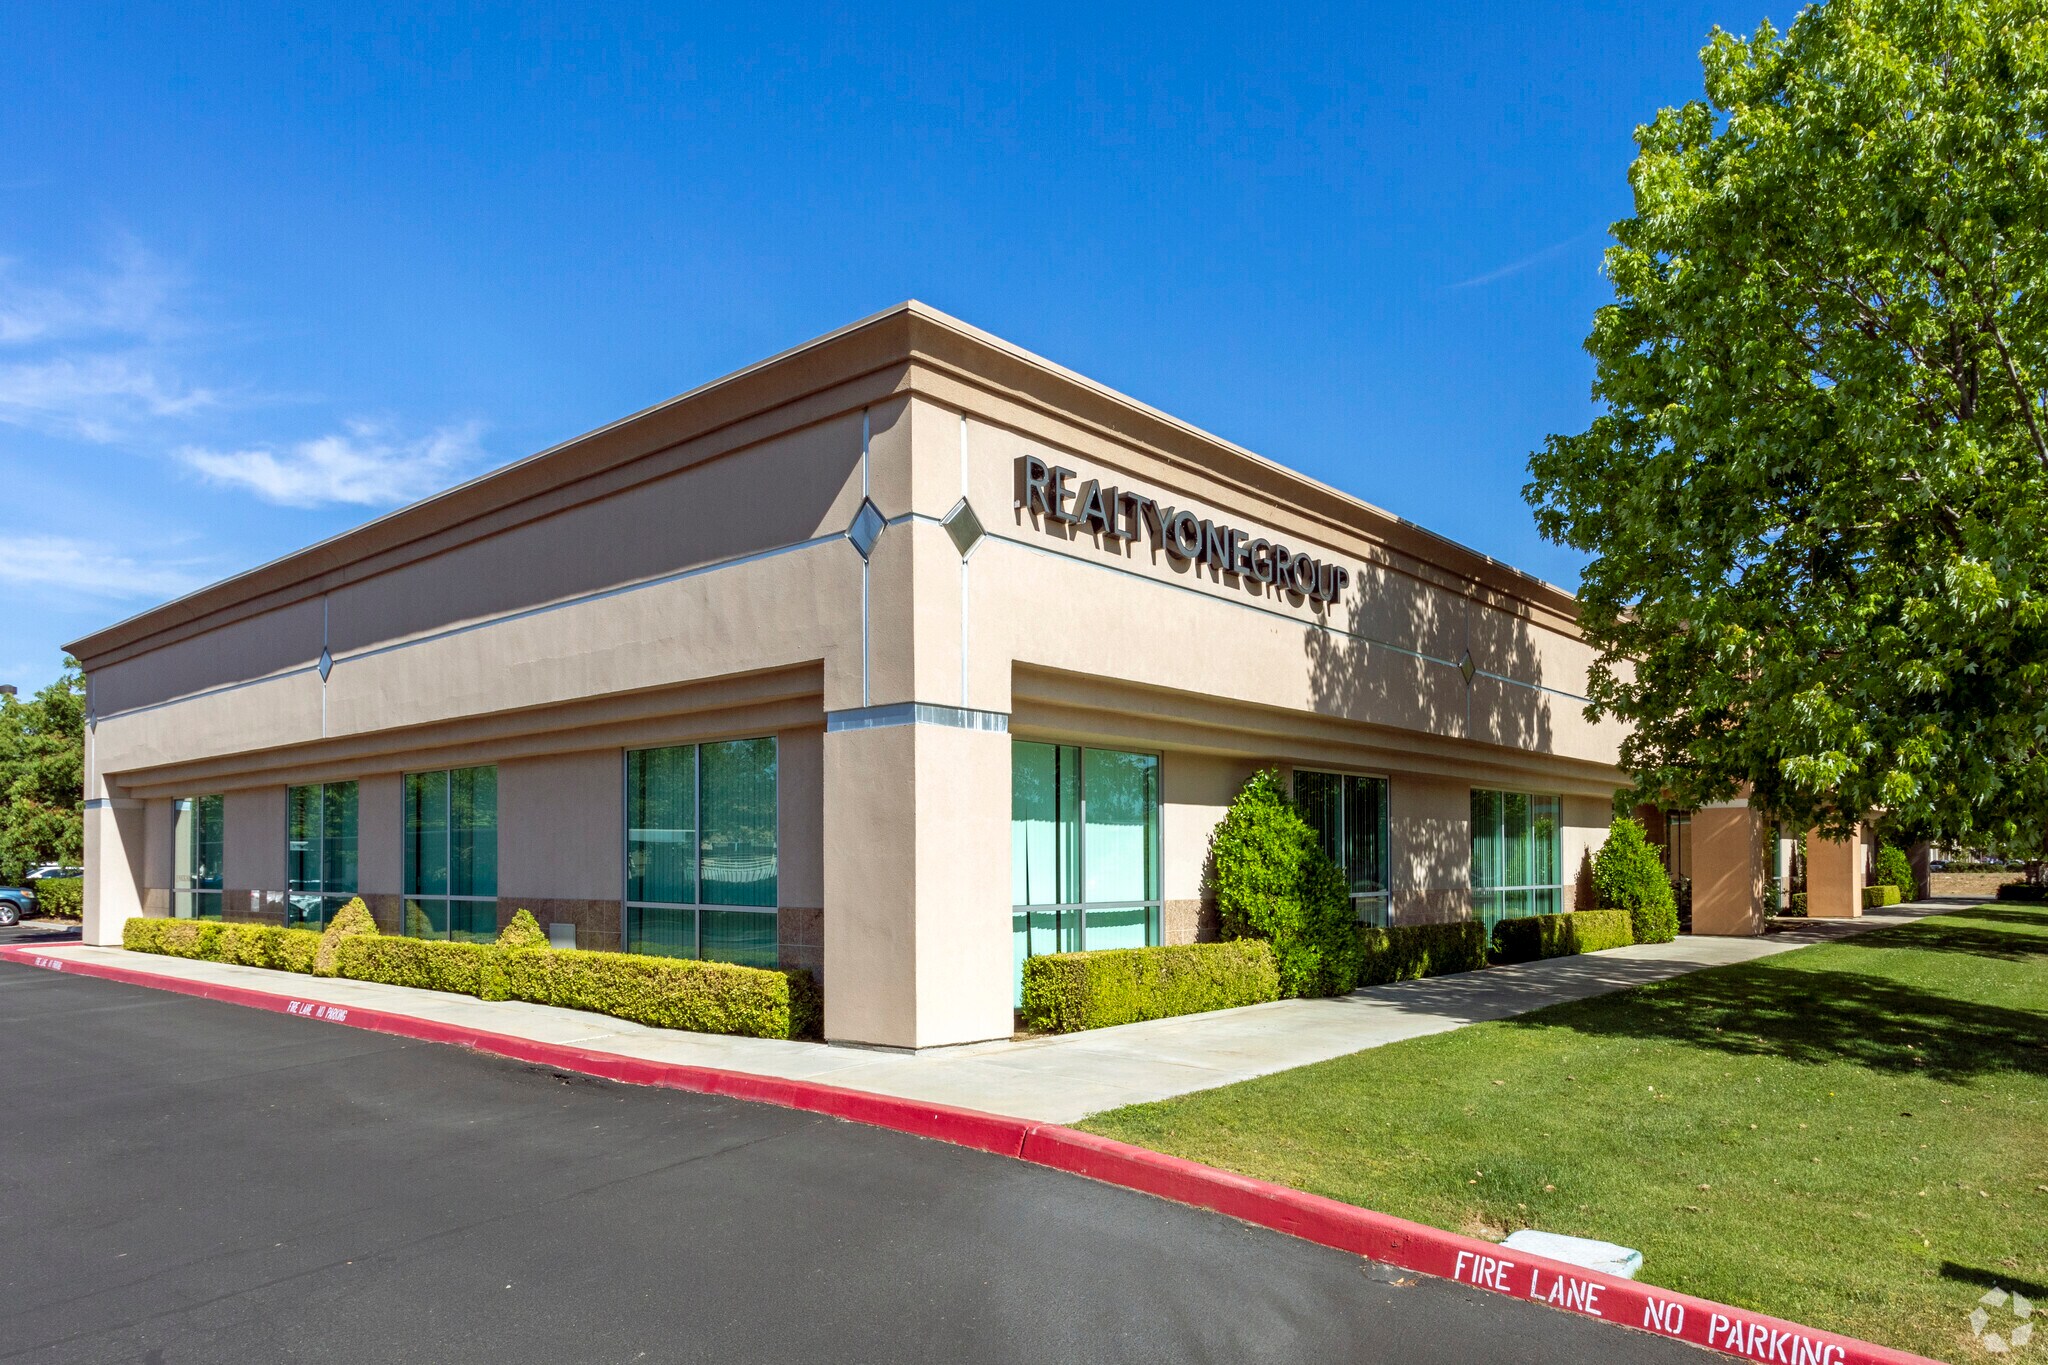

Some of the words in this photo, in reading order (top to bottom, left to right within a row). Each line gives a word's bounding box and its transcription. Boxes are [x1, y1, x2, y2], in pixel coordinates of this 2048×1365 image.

[1454, 1251, 1514, 1291] FIRE
[1530, 1269, 1606, 1315] LANE
[1643, 1297, 1684, 1334] NO
[1708, 1313, 1845, 1365] PARKING
